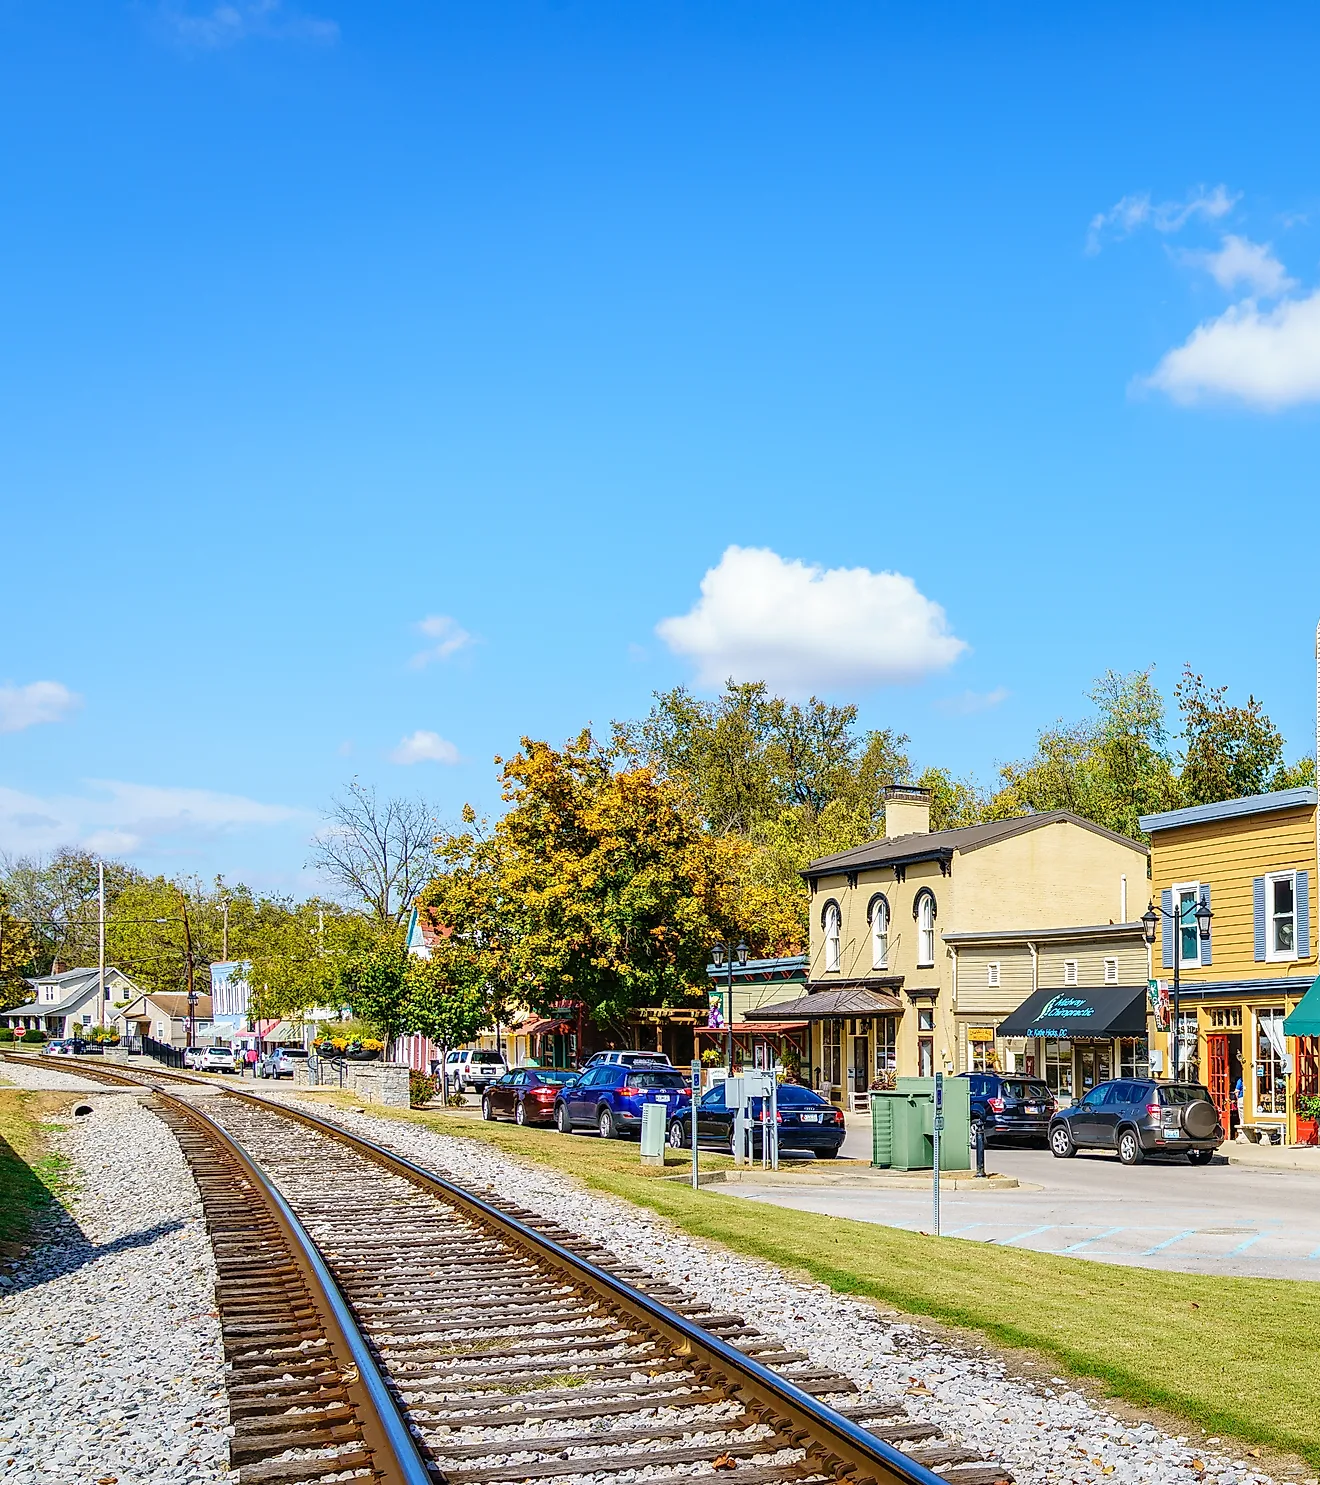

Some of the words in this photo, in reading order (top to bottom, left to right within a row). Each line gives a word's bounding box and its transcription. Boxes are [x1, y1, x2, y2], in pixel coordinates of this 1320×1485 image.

[1055, 997, 1087, 1007] Midway
[1048, 1007, 1095, 1018] Chiropractic
[1059, 1028, 1068, 1036] DC
